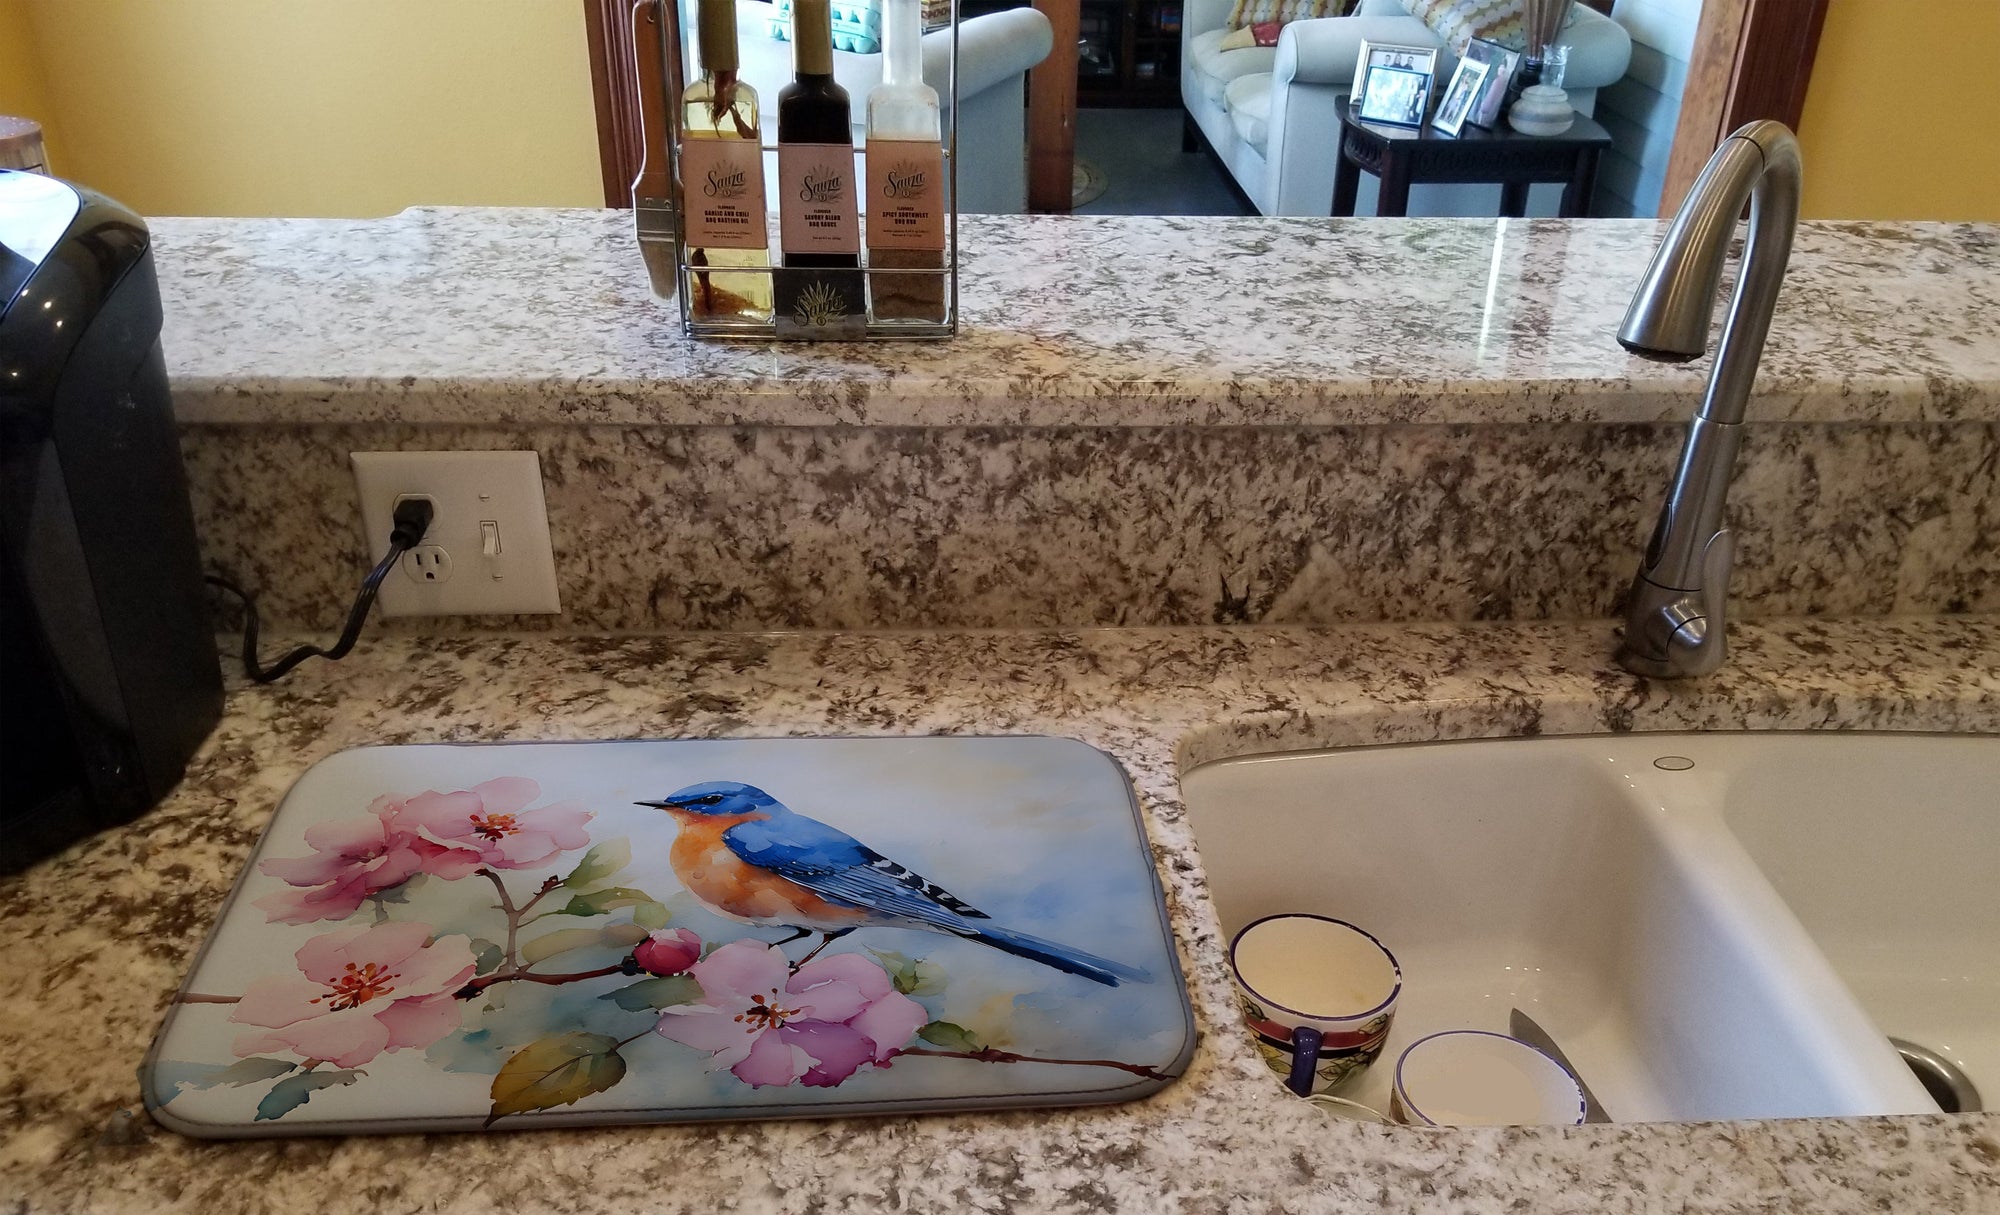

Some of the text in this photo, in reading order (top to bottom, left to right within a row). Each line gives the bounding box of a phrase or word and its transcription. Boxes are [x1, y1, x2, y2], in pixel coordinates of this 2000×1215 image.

[704, 170, 746, 197] Sauza
[800, 175, 842, 202] Sauza
[884, 171, 926, 198] Sauza
[793, 295, 844, 326] Sauza
